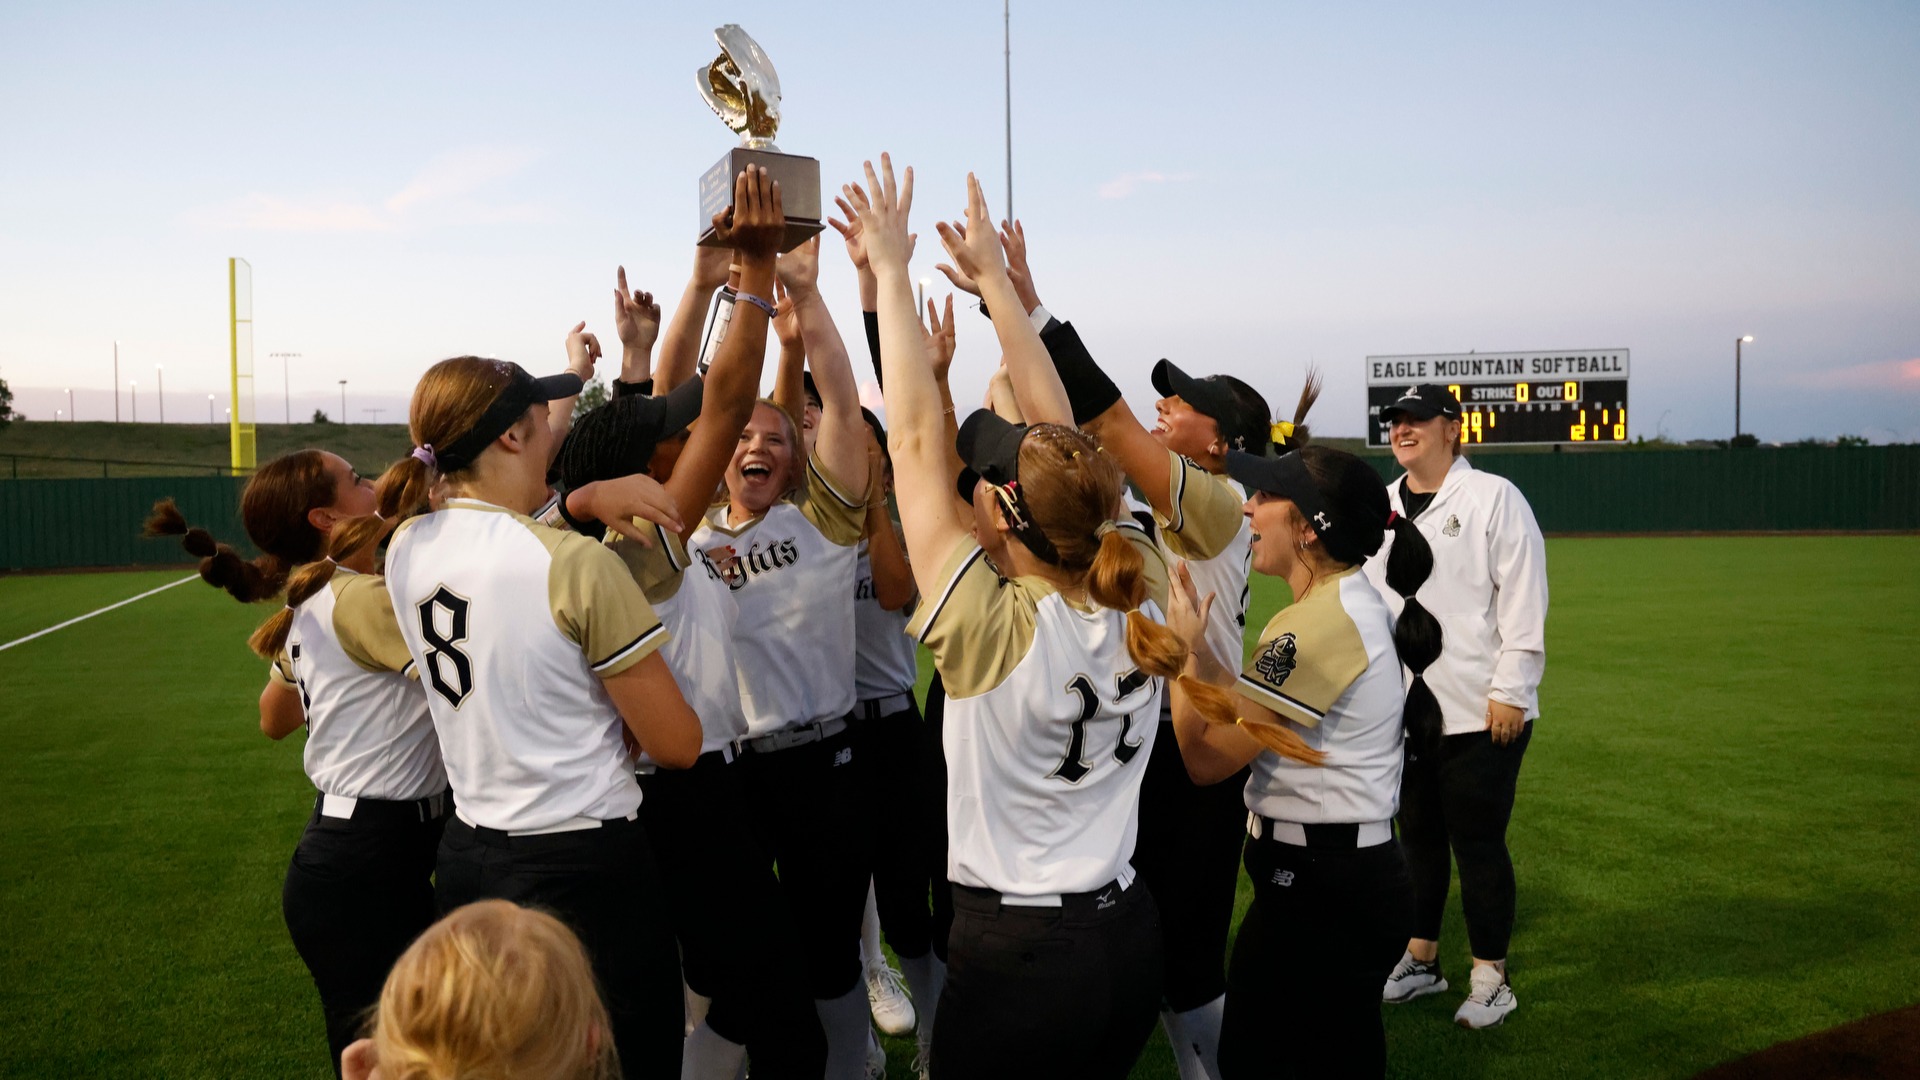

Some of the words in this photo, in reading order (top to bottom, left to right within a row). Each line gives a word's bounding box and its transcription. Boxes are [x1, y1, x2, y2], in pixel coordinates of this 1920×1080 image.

[1372, 361, 1427, 378] EAGLE
[1434, 358, 1524, 377] MOUNTAIN
[1532, 355, 1622, 374] SOFTBALL
[1471, 387, 1515, 401] STRIKE
[1516, 382, 1529, 403] 0
[1536, 386, 1562, 399] OUT
[1564, 380, 1577, 401] 0
[415, 583, 476, 711] 8
